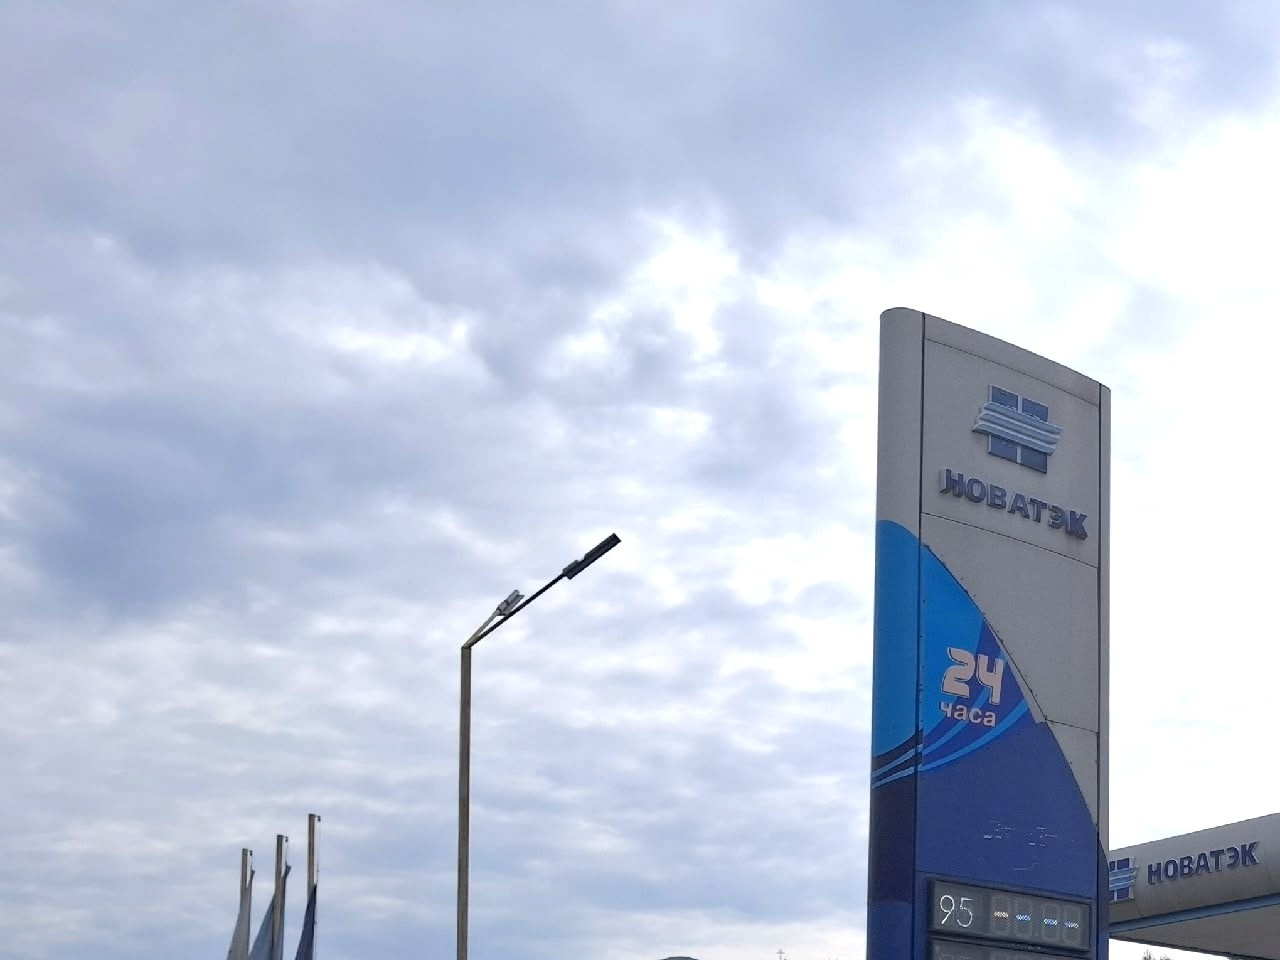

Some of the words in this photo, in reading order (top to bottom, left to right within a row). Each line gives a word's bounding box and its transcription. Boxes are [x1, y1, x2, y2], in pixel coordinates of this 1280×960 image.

[939, 467, 1088, 541] НОВАТЭК
[941, 647, 1006, 706] 24
[940, 700, 997, 728] часа
[1147, 841, 1260, 885] НОВАТЭК
[939, 893, 974, 928] 95
